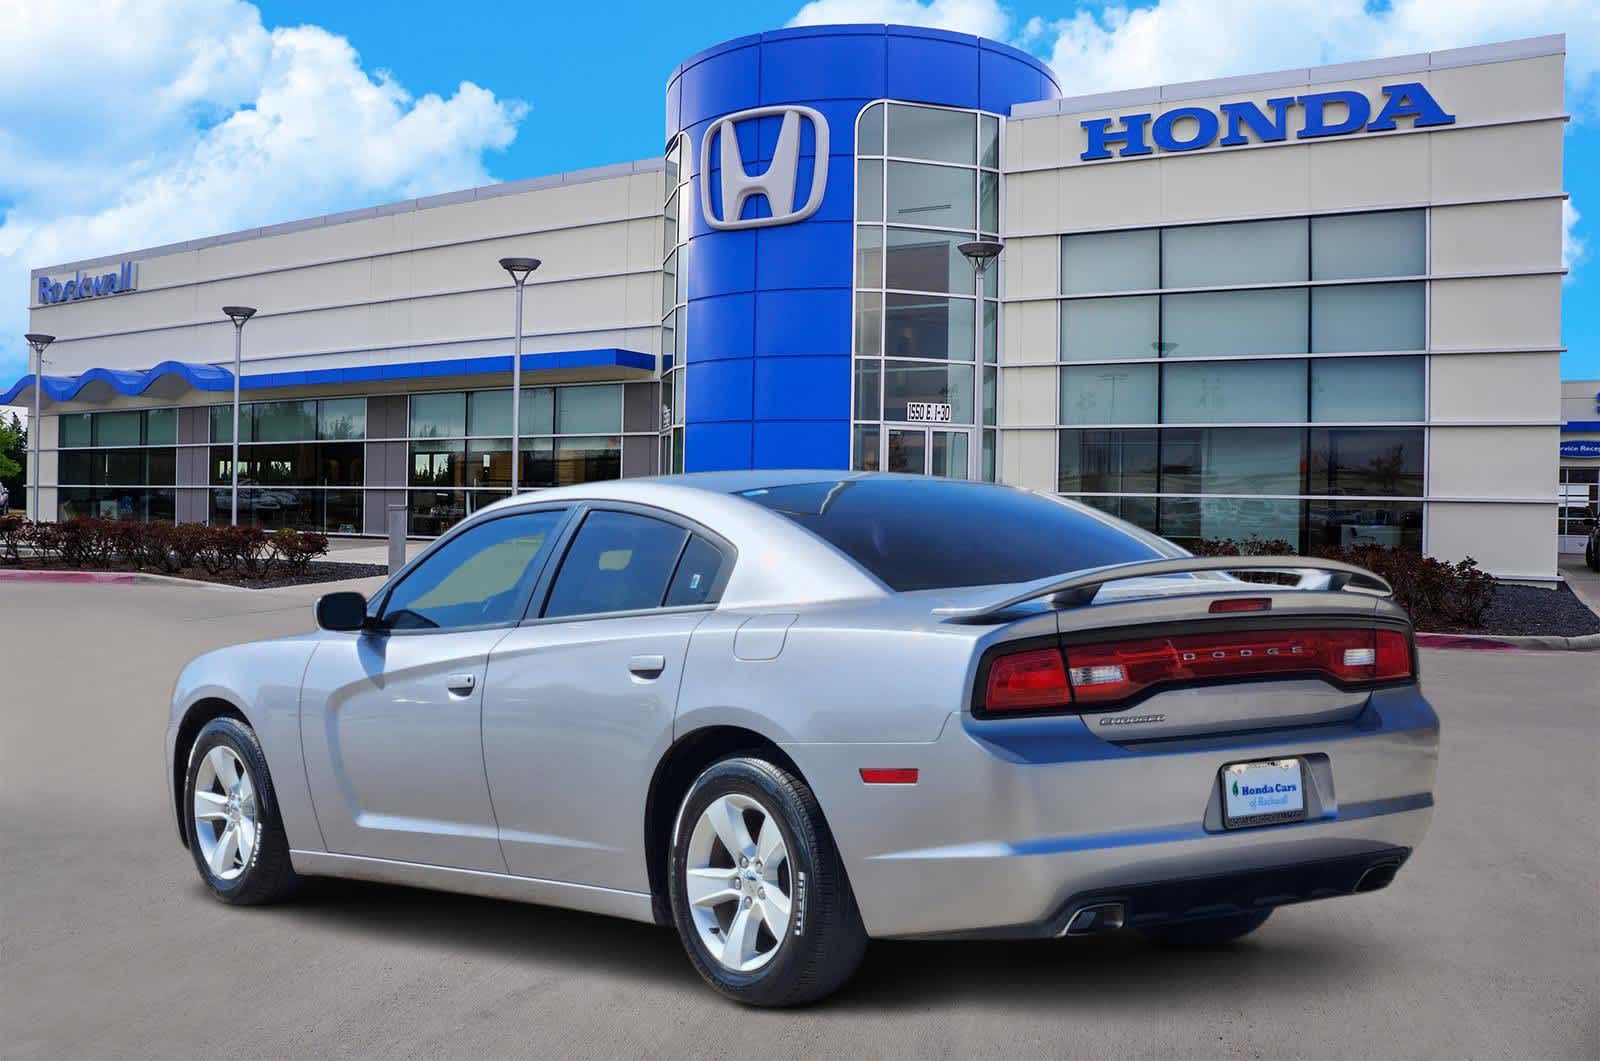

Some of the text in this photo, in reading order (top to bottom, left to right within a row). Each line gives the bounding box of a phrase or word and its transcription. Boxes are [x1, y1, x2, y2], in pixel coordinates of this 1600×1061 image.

[1080, 82, 1456, 161] HONDA
[38, 261, 133, 304] Rockwall
[908, 404, 950, 421] 1550 E. I-30
[1183, 646, 1302, 661] DODGE
[1242, 783, 1297, 796] Honda Cars
